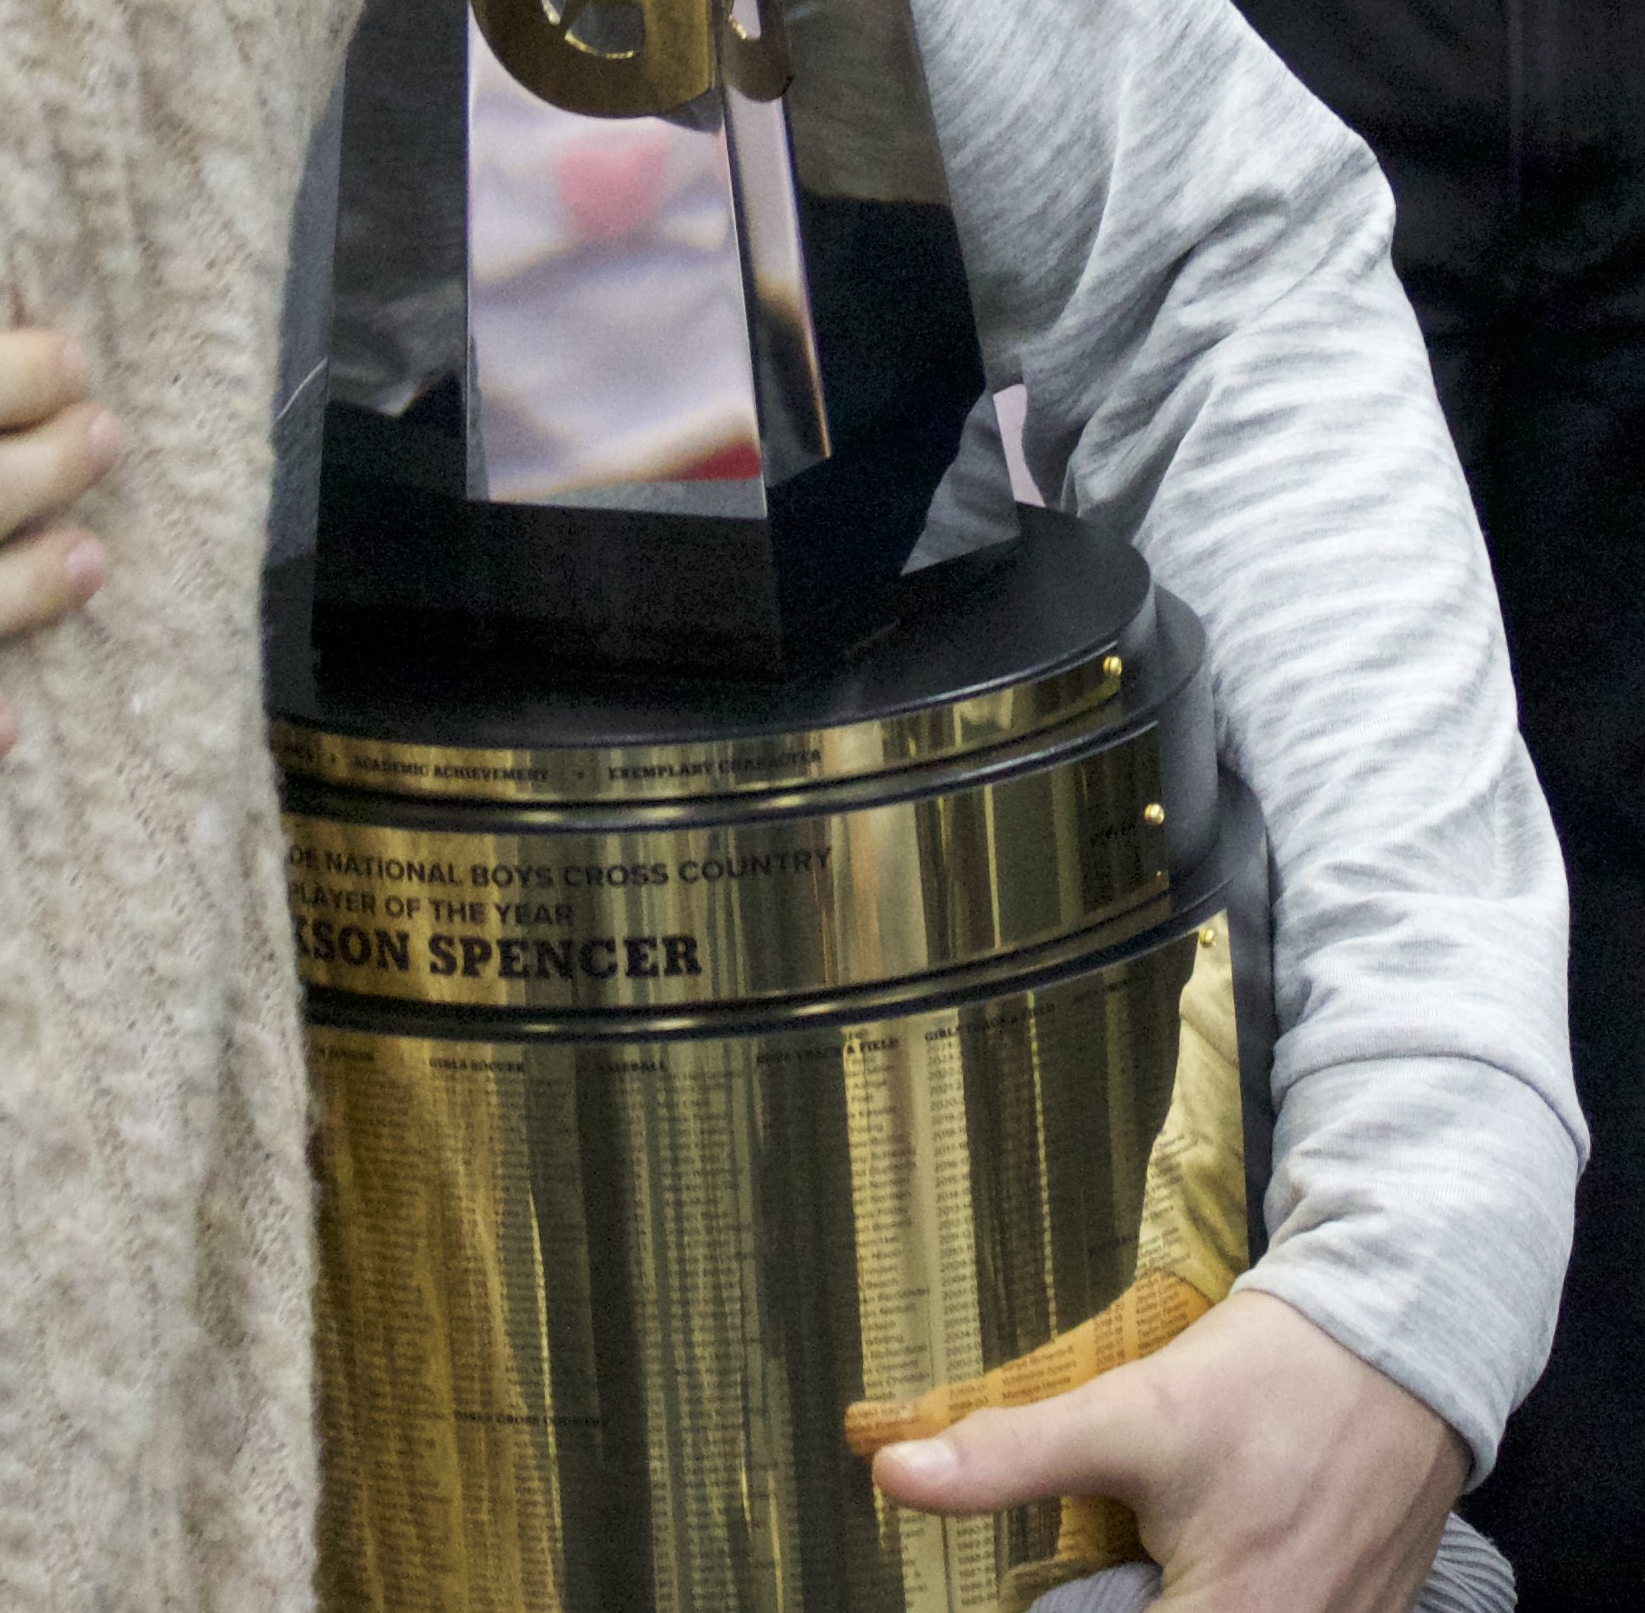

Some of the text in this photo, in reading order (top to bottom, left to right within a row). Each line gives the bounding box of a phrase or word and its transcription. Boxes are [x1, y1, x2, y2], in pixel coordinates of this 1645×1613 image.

[433, 764, 549, 782] ACHIEVEMENT
[325, 850, 463, 885] NATIONAL
[470, 863, 554, 887] BOYS
[563, 862, 669, 887] CROSS
[677, 847, 831, 883] COUNTRY
[385, 895, 420, 919] OF
[429, 898, 486, 924] THE
[494, 902, 575, 927] YEAR
[427, 932, 702, 979] SPENCER
